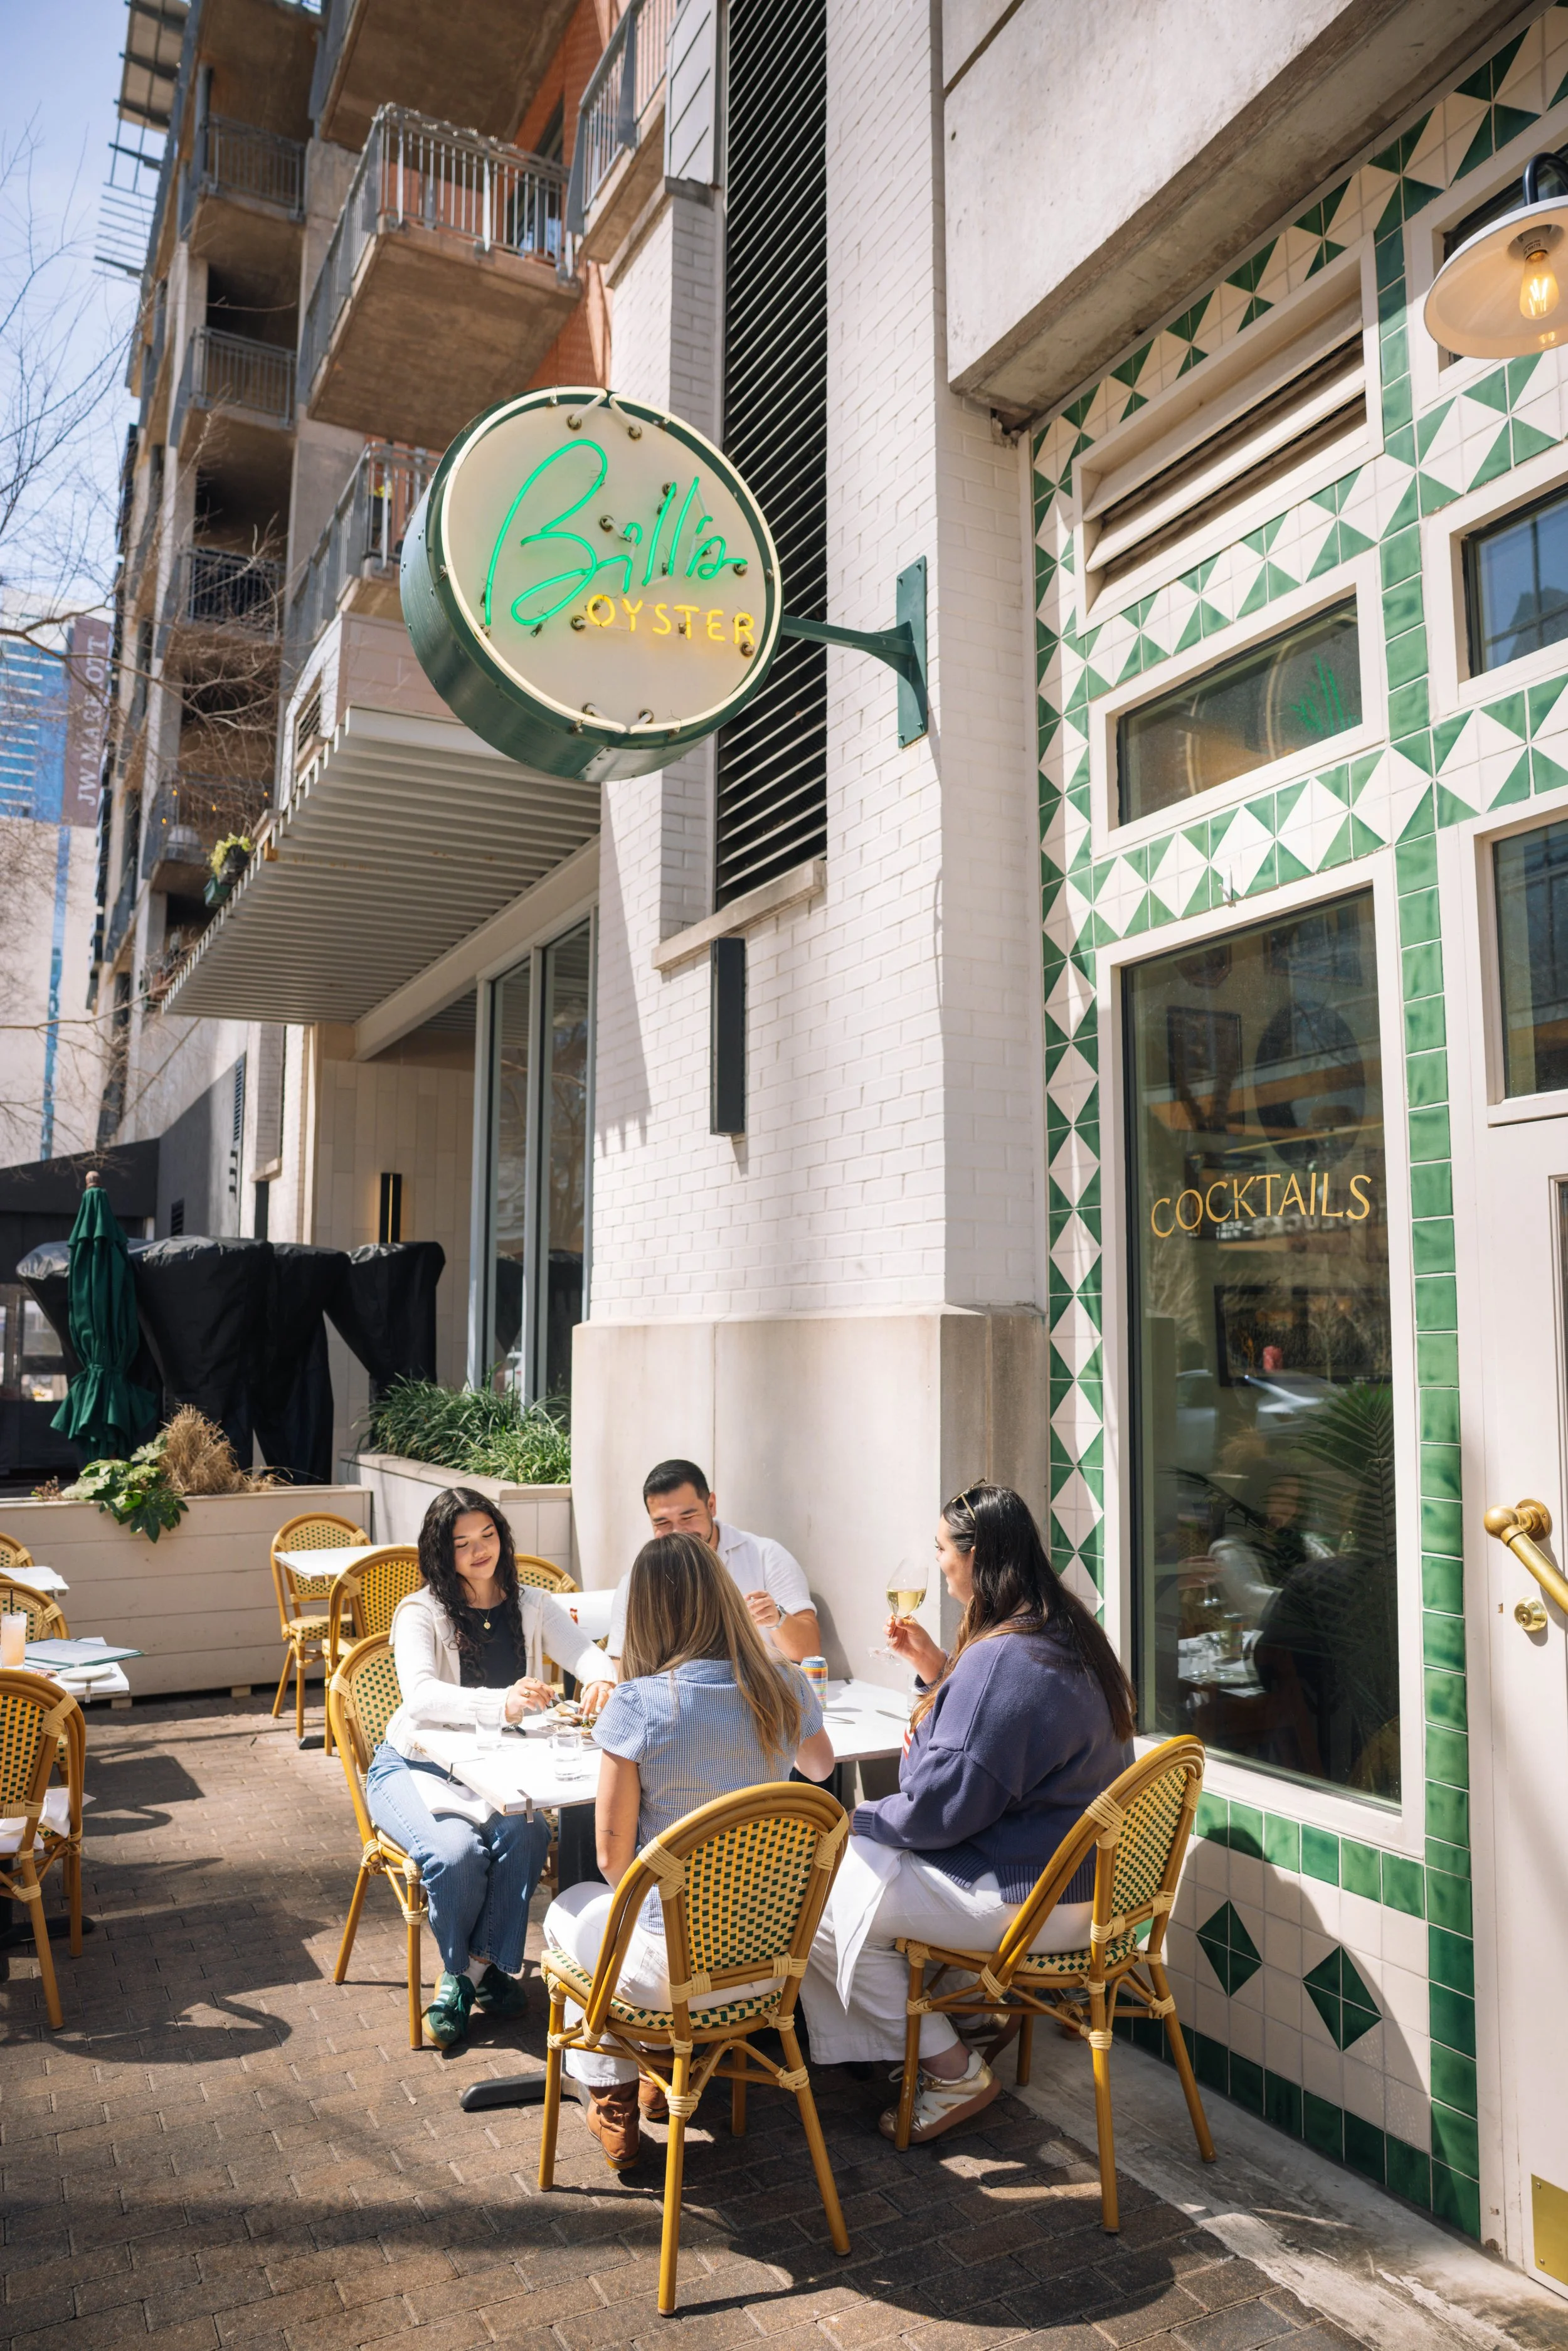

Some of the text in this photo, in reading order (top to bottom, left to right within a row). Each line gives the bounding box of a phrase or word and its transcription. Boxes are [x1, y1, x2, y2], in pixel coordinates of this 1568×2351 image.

[485, 439, 748, 626] Bill's
[586, 594, 755, 645] OYSTER
[77, 635, 106, 806] JW MARROTT
[1151, 1172, 1372, 1238] COCKTAILS
